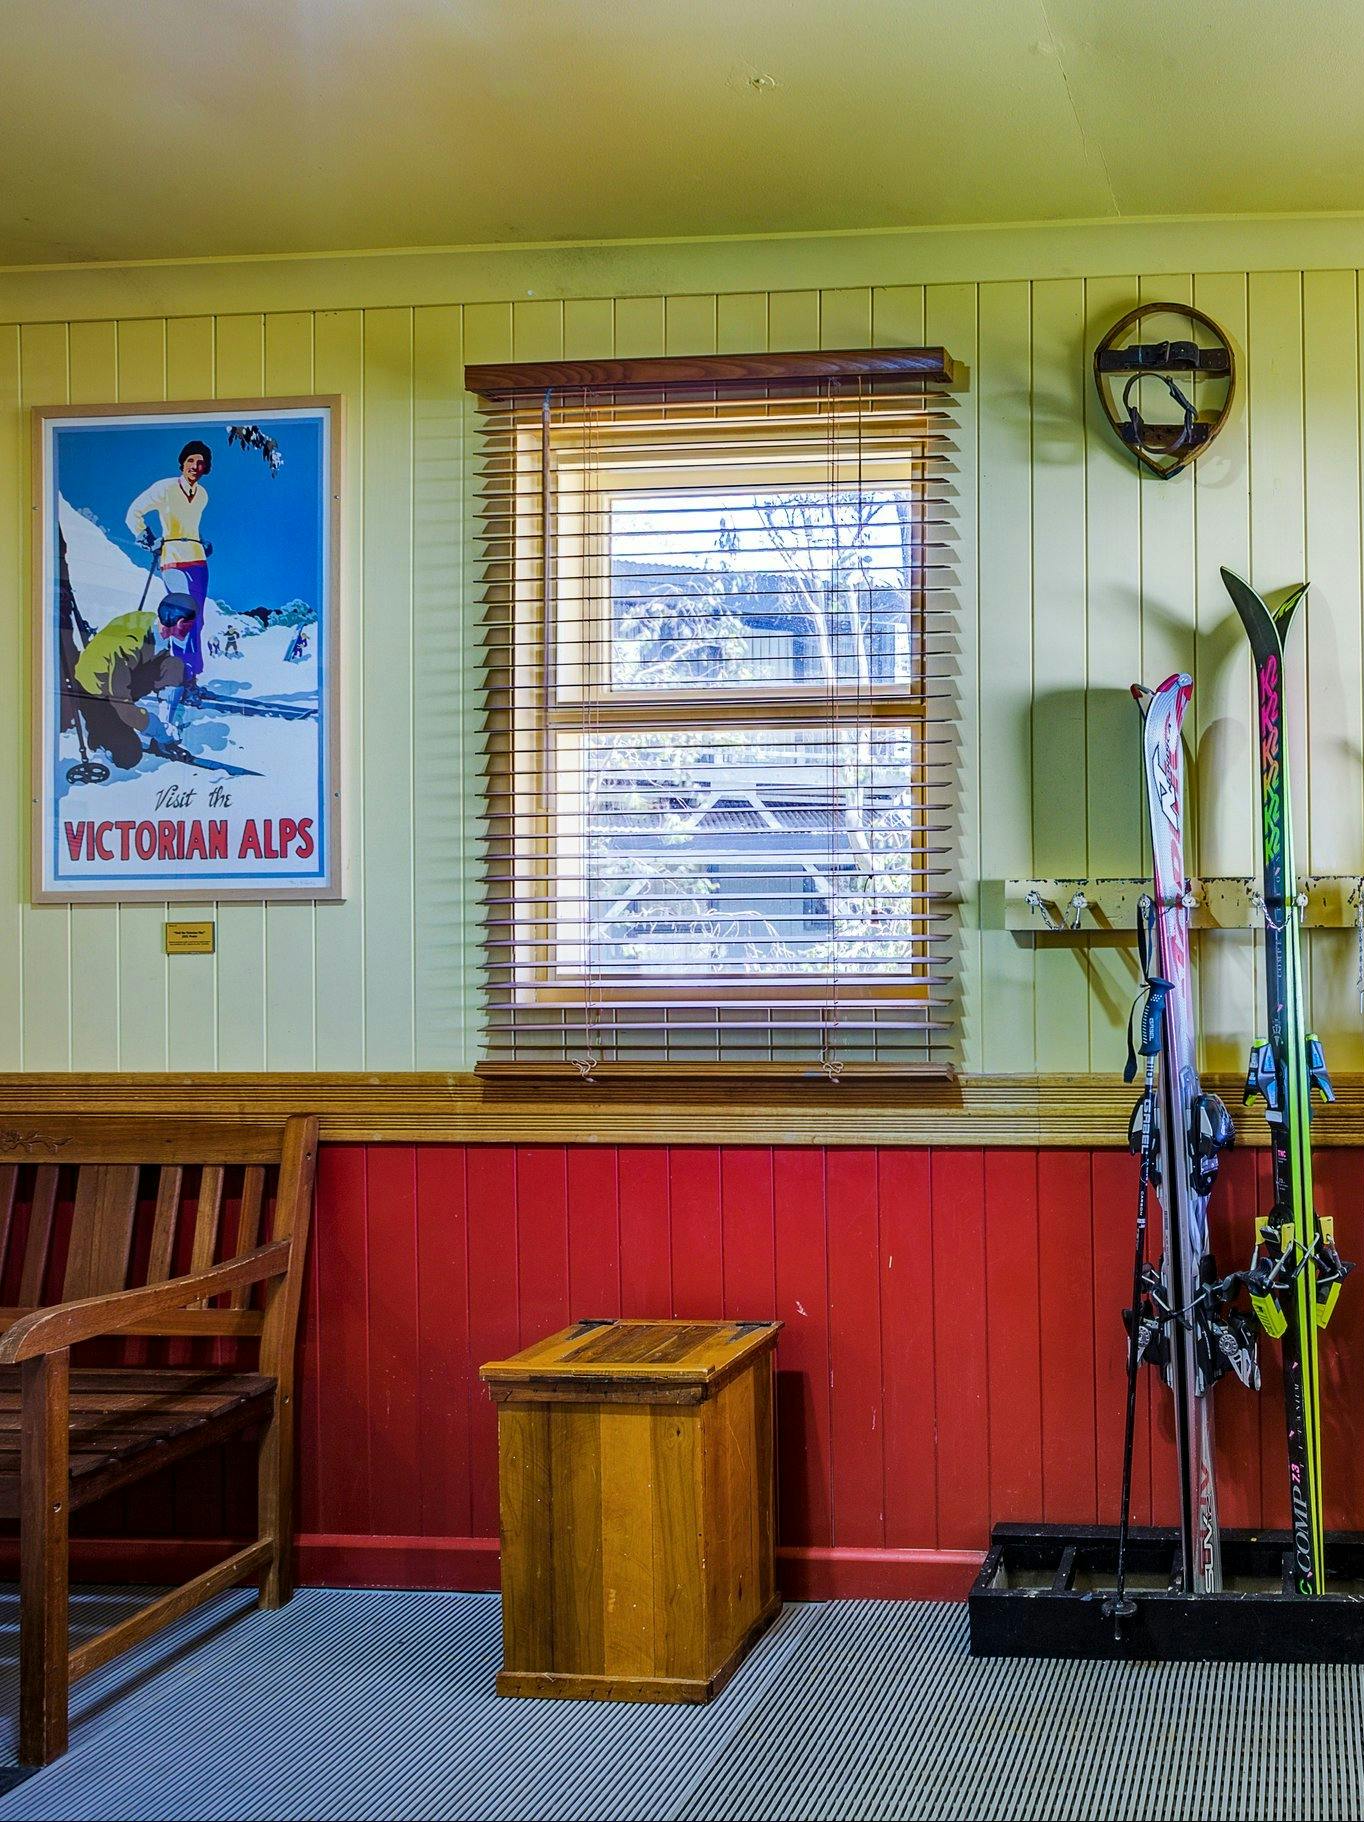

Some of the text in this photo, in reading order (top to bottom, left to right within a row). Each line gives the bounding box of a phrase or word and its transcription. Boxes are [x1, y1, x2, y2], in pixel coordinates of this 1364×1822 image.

[154, 784, 233, 811] Visit the
[63, 816, 314, 862] VICTORIAN ALPS
[1141, 1098, 1152, 1155] GABEL
[1291, 1463, 1302, 1483] 7.3
[1292, 1487, 1313, 1573] COMP
